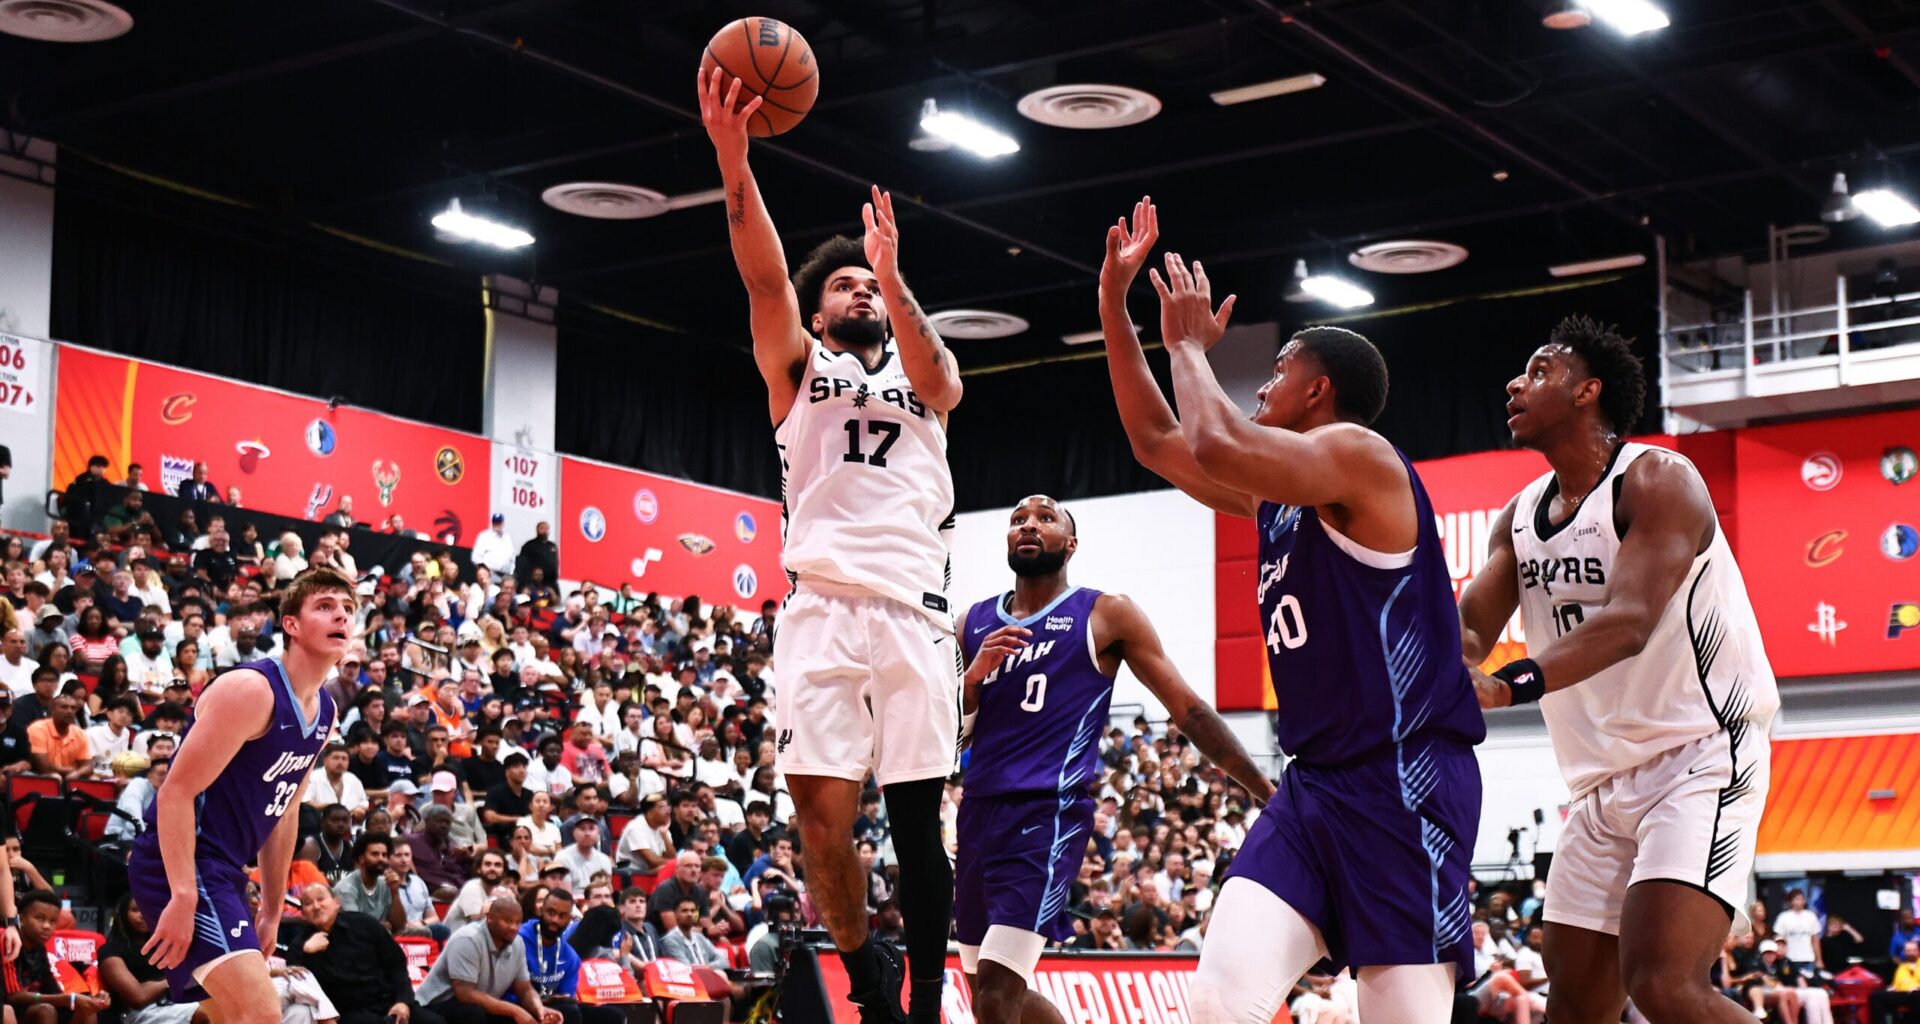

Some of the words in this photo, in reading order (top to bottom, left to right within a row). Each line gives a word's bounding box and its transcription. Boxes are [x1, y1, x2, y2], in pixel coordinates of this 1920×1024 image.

[843, 418, 902, 468] 17
[513, 455, 538, 477] 107
[512, 486, 537, 508] 108
[1045, 623, 1073, 632] Equity
[1047, 615, 1074, 625] Health
[1267, 594, 1308, 655] 40
[1020, 673, 1047, 713] 0
[264, 781, 298, 817] 33
